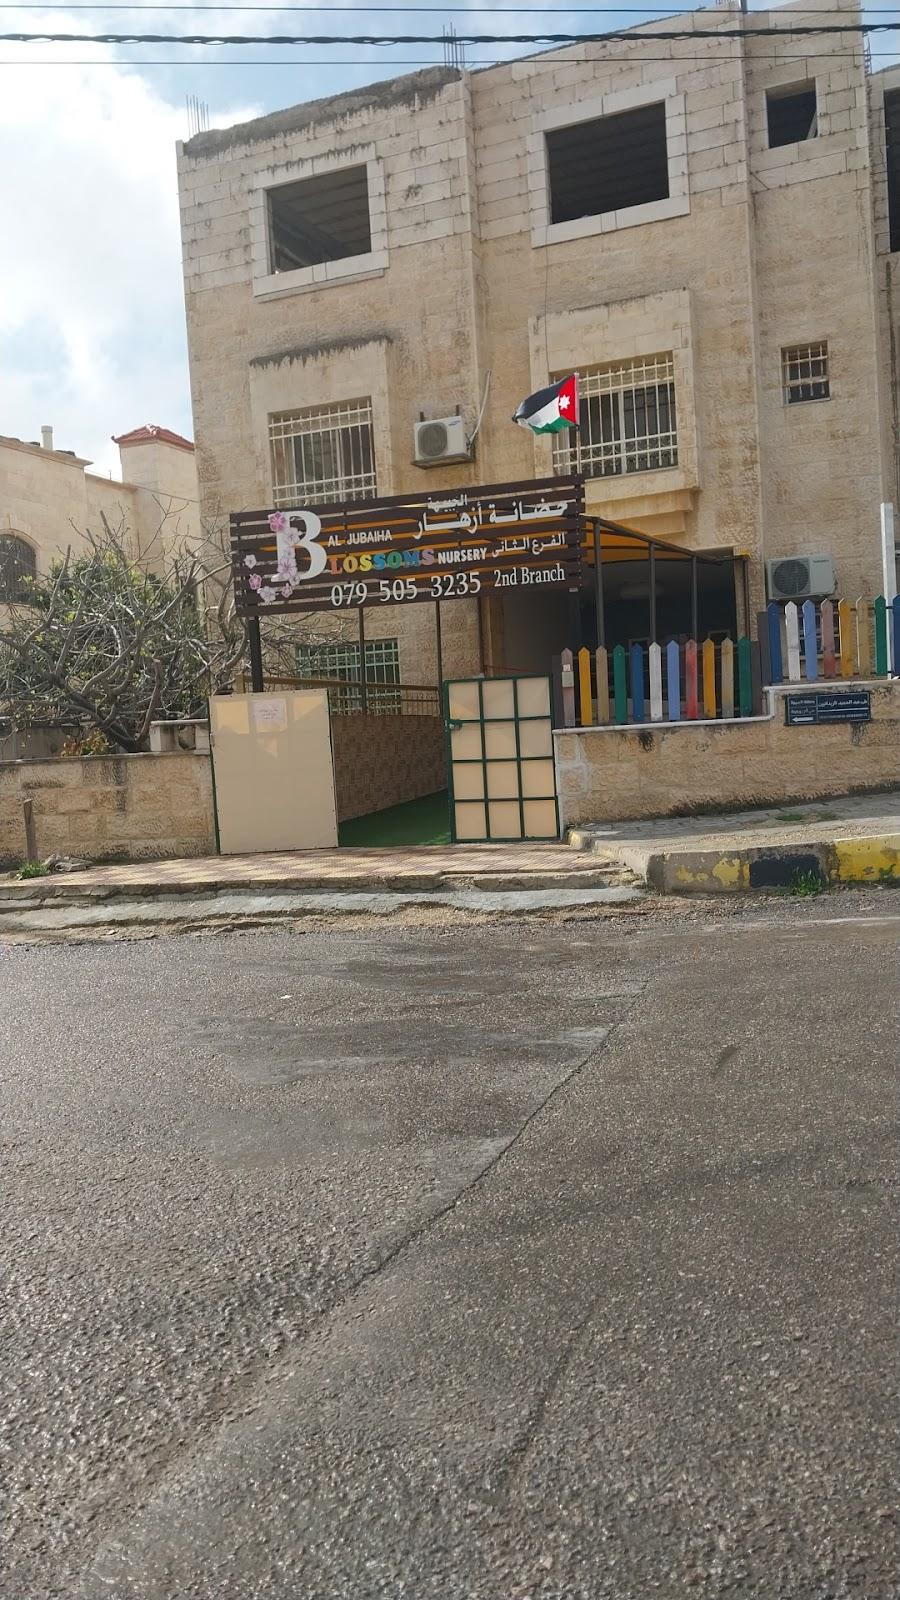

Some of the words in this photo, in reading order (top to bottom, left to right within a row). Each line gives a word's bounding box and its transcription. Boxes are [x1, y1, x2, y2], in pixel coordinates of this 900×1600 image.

[412, 502, 483, 539] أزهار
[489, 498, 568, 524] حضانة
[328, 535, 342, 548] AL
[346, 529, 393, 546] JUBAIHA
[532, 531, 566, 555] الفرع
[438, 547, 487, 565] NURSERY
[331, 583, 368, 607] 079
[379, 577, 418, 602] 505
[431, 571, 482, 598] 3235
[494, 567, 518, 588] 2nd
[521, 562, 566, 585] Branch
